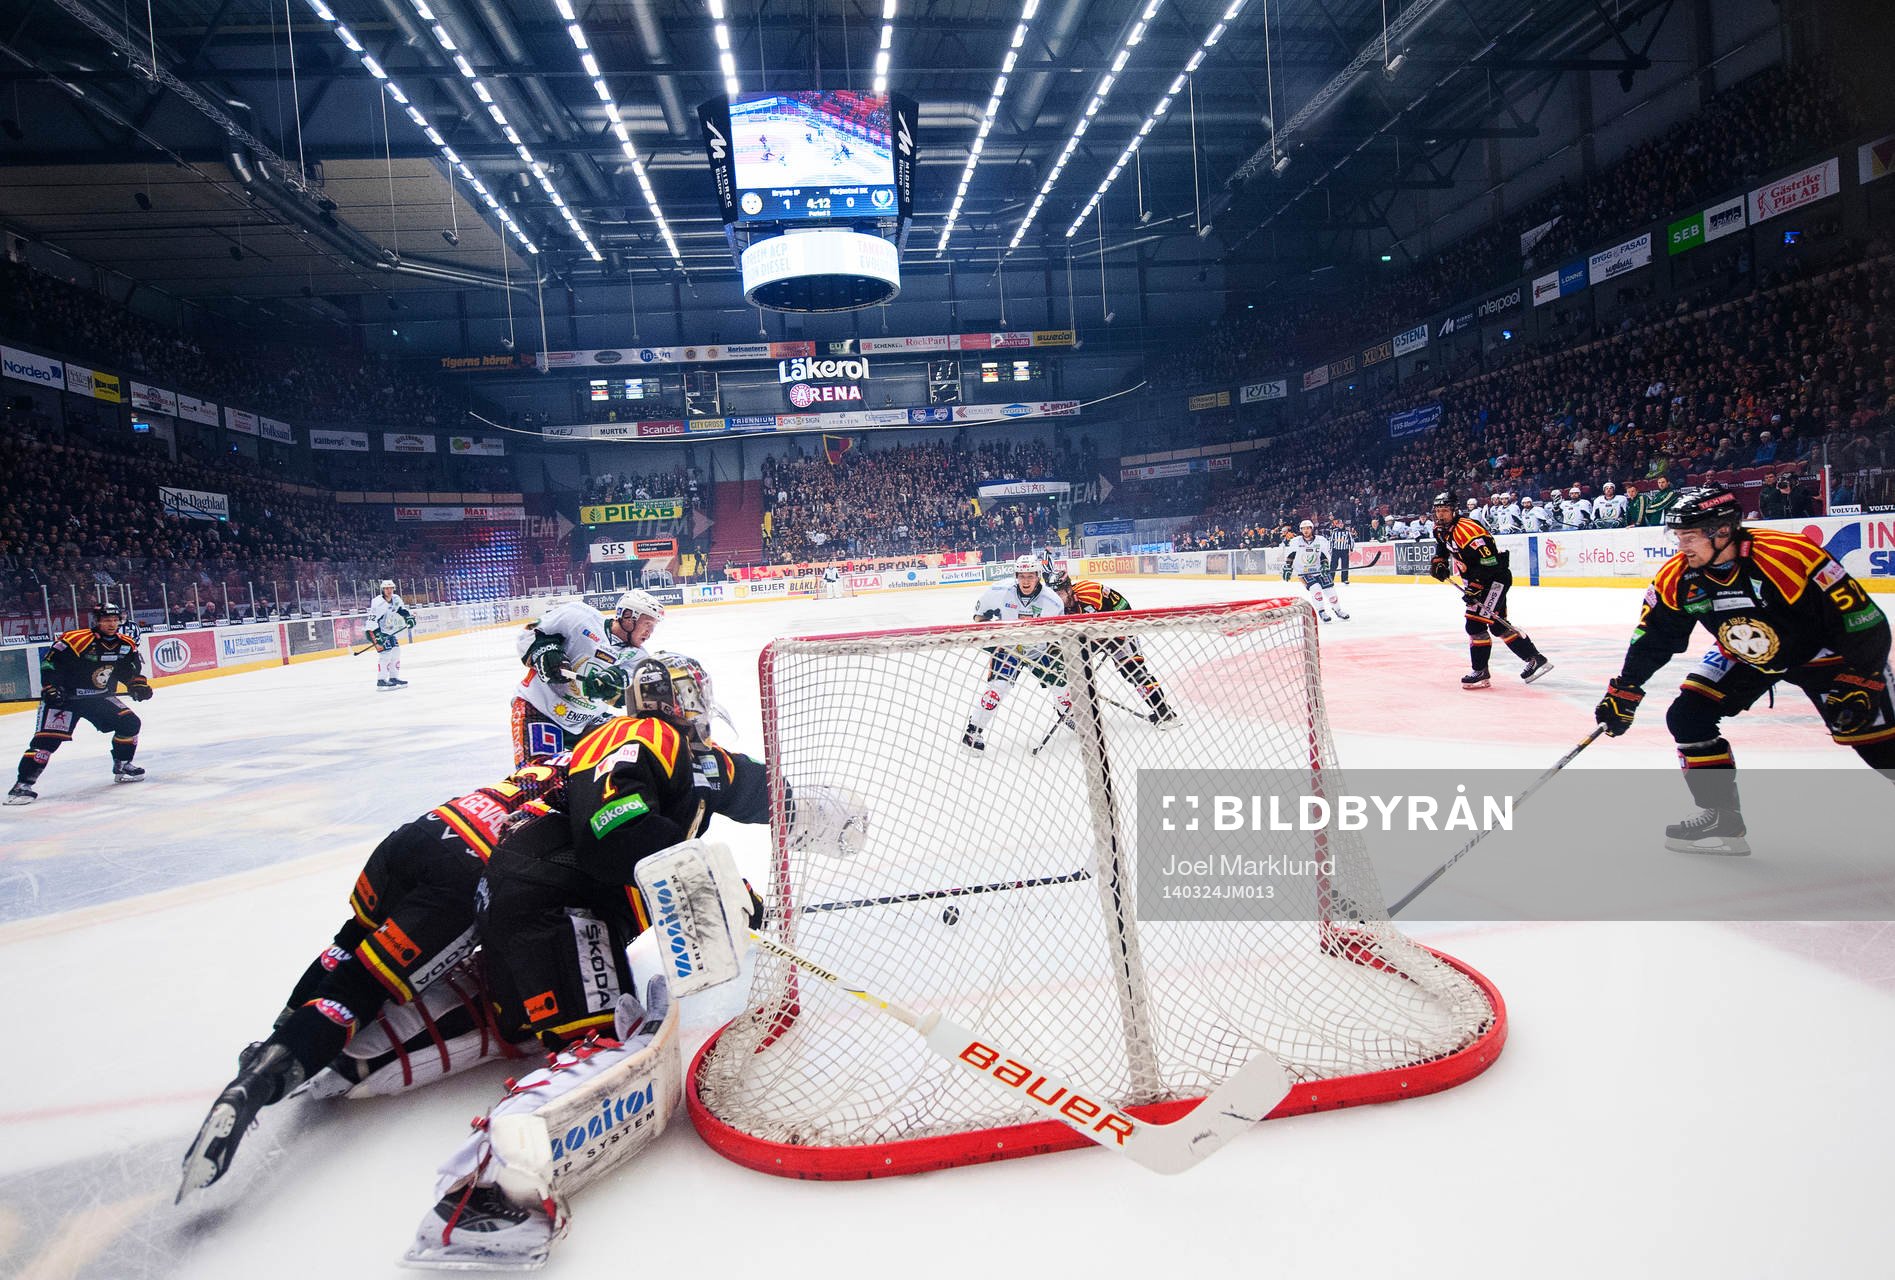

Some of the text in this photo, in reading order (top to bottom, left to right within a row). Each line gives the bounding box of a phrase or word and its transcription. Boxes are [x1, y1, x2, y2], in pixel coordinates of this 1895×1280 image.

[722, 165, 733, 208] MIDROC
[1769, 173, 1821, 198] Gästrike
[1800, 184, 1820, 199] AB
[783, 199, 791, 210] 1
[806, 198, 831, 209] 4:12
[846, 197, 854, 208] 0
[1709, 212, 1740, 231] KPMG
[1672, 224, 1700, 243] SEB
[1591, 252, 1612, 265] BYGG
[1620, 237, 1648, 253] FASAD
[1478, 288, 1520, 317] interpool
[995, 338, 1030, 346] VANTUM
[1401, 327, 1426, 344] STENA
[4, 360, 51, 381] Nordea
[778, 357, 870, 384] Läkerol
[795, 385, 862, 403] ARENA
[600, 427, 628, 435] MURTEK
[642, 424, 680, 434] Scandic
[1004, 484, 1046, 494] ALLSTAR
[190, 494, 225, 511] Dagblad
[1869, 504, 1895, 512] VOLVI
[605, 506, 675, 521] PIRAB
[601, 543, 626, 555] SFS
[1478, 547, 1491, 558] 18
[1578, 549, 1635, 565] skfab.se
[798, 565, 849, 576] BRINER
[990, 565, 1014, 577] Läke
[1089, 560, 1115, 573] BYGG
[751, 583, 785, 592] BEIJER
[4, 636, 25, 644] VOLVIA
[29, 634, 49, 642] VOLVIA
[593, 800, 642, 832] Läkerol
[652, 879, 693, 978] monitor
[415, 938, 474, 986] KODA
[587, 1109, 656, 1159] SYSTEM
